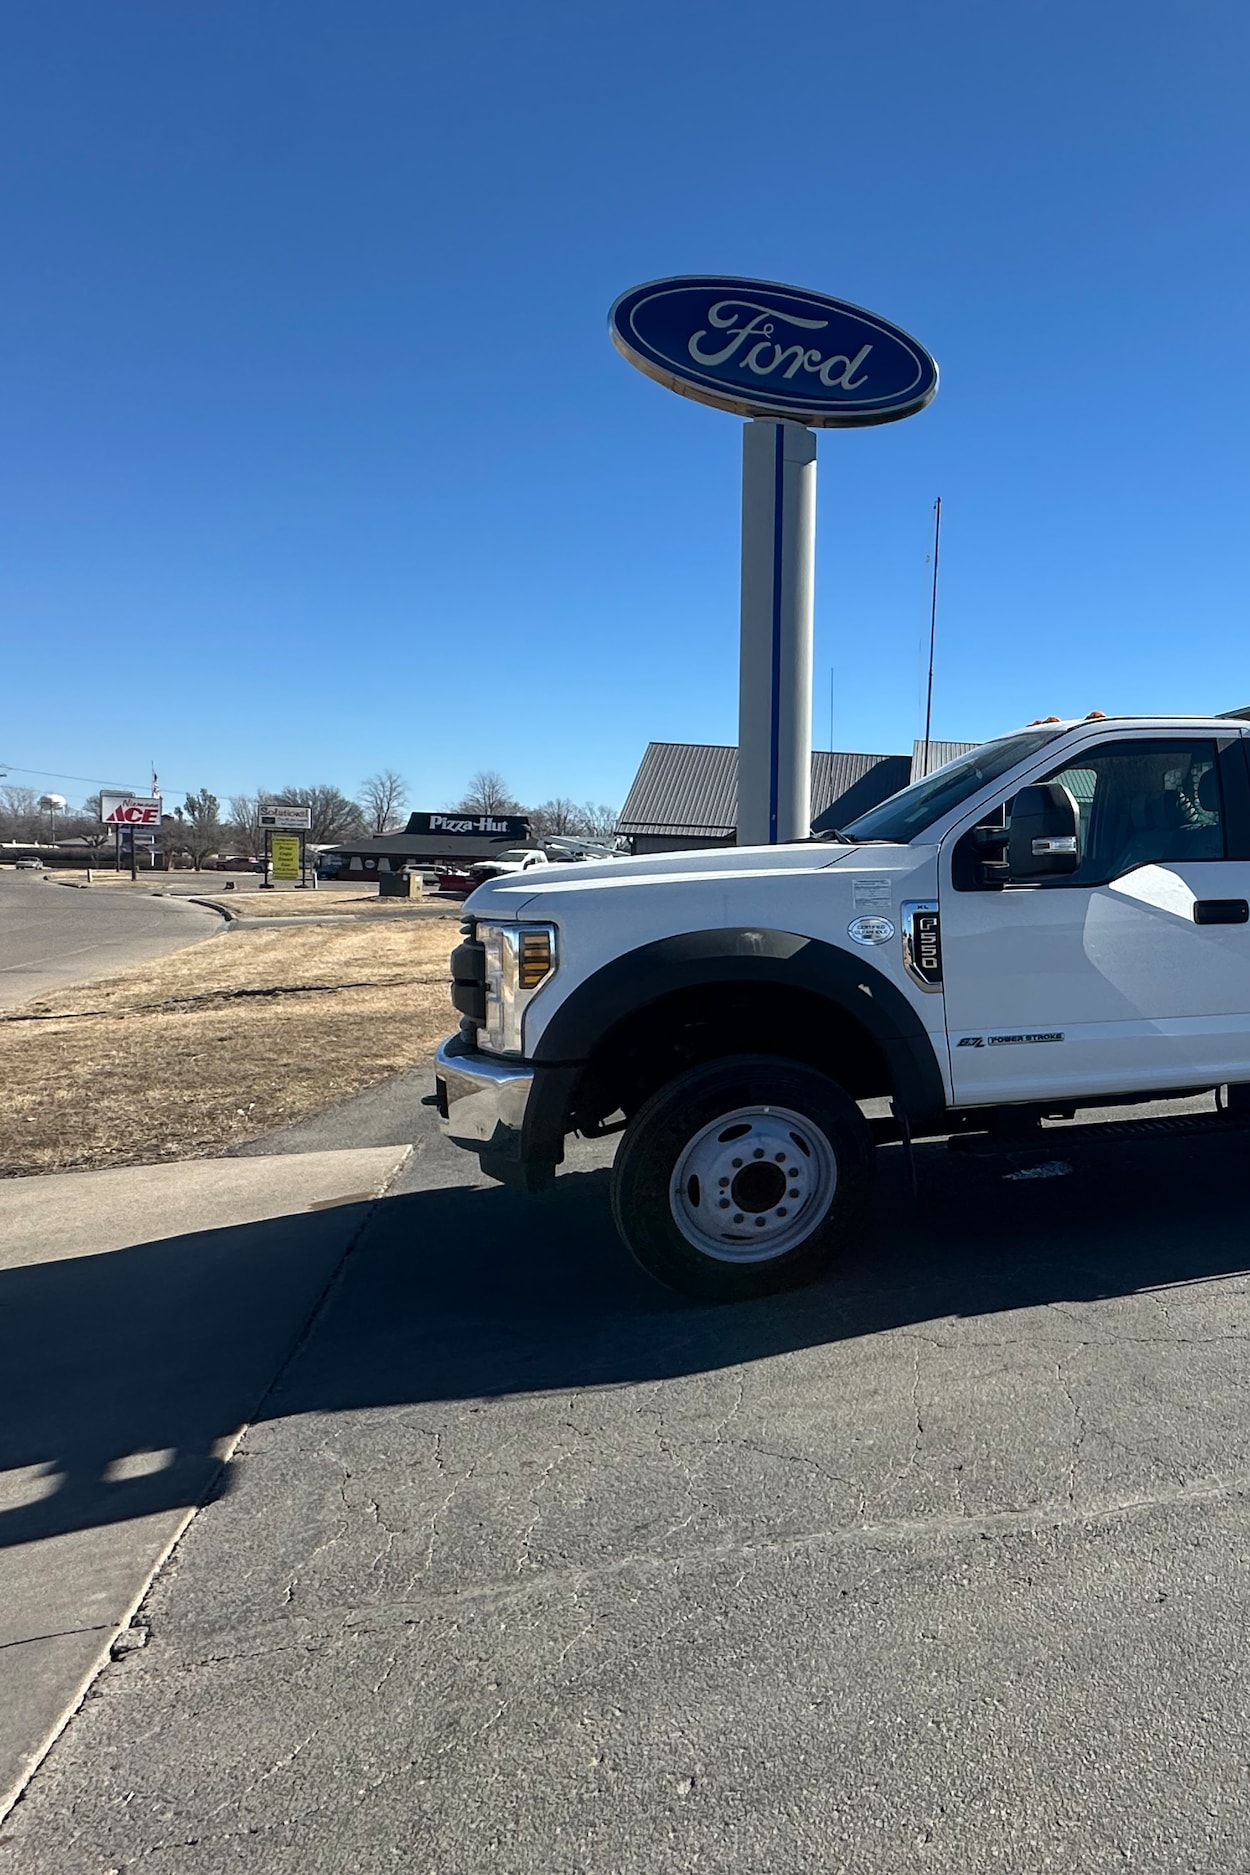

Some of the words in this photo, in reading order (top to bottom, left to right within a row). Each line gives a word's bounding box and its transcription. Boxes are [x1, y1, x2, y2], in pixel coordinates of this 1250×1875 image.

[688, 300, 873, 390] Ford
[106, 805, 159, 823] ACE
[429, 815, 473, 832] Pizza
[474, 817, 508, 832] Hut
[920, 918, 937, 968] F550
[991, 1035, 1024, 1044] POWER
[1026, 1032, 1062, 1041] STROKE
